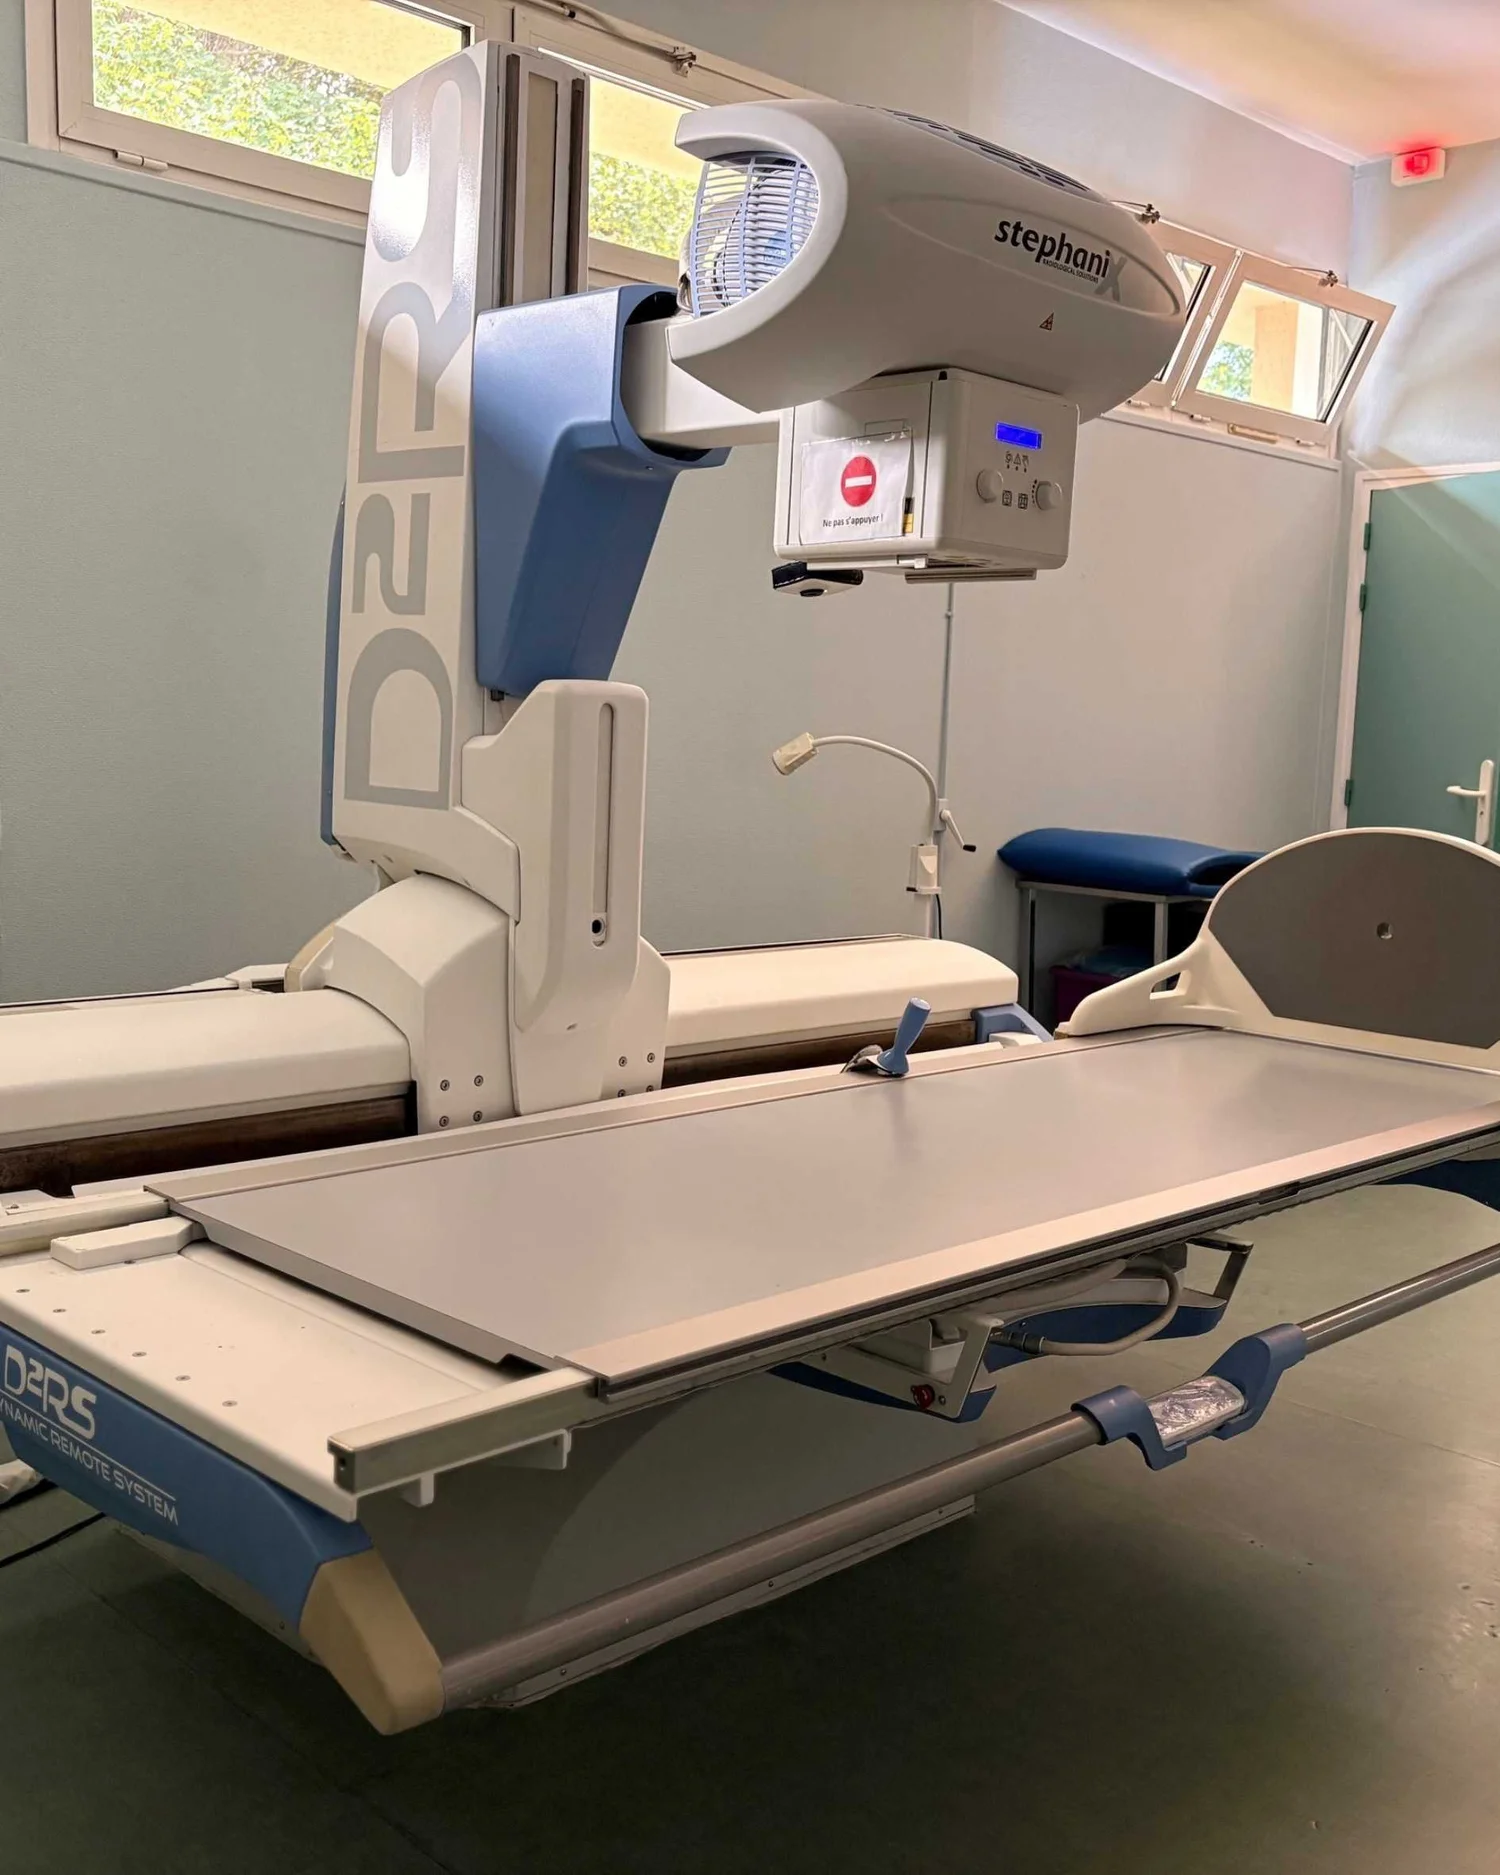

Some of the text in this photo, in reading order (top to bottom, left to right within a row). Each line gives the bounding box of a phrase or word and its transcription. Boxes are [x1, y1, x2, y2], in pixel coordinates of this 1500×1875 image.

[822, 519, 832, 527] Ne
[833, 519, 845, 528] pas
[846, 514, 880, 526] s'appuyer
[50, 1429, 111, 1482] REMOTE
[113, 1469, 179, 1527] SYSTEM
